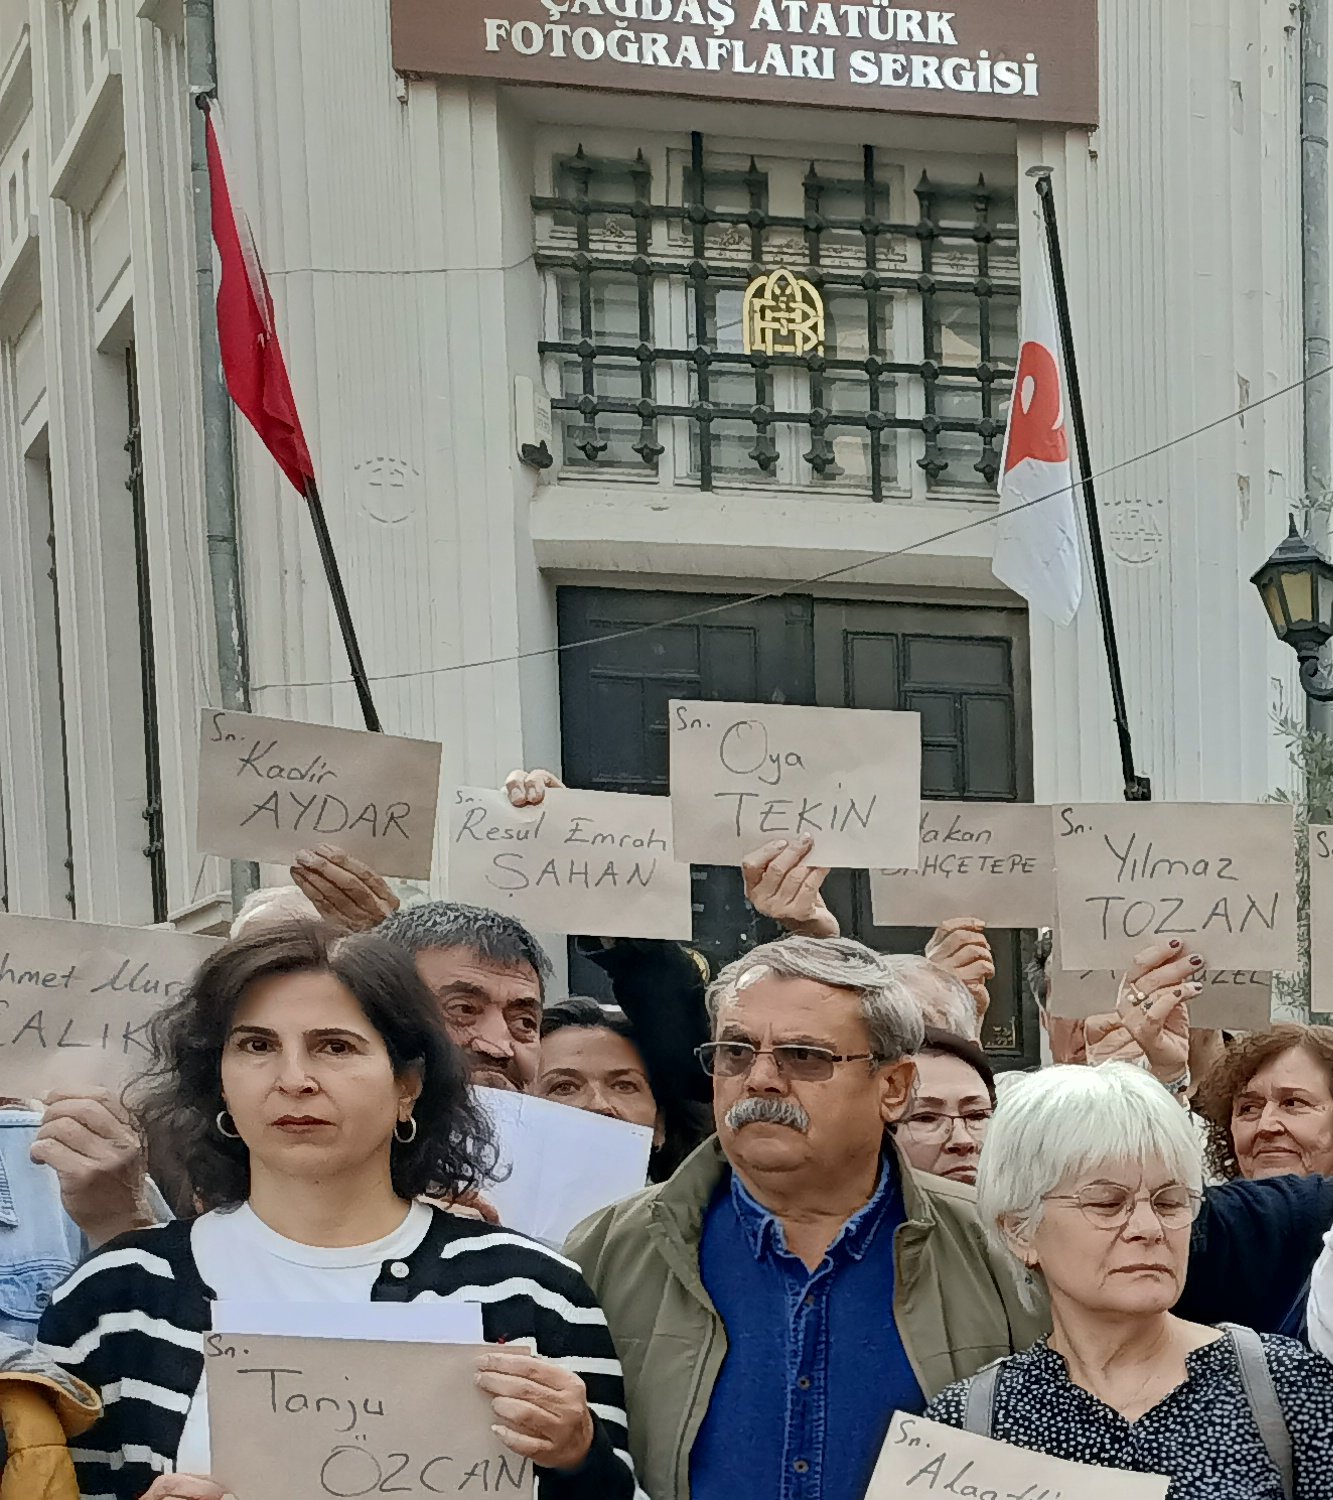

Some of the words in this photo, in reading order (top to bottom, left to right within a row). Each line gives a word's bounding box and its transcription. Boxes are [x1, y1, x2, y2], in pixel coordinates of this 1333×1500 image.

[750, 0, 958, 45] ATATÜRK
[484, 18, 836, 80] FOTOĞRAFLARI
[848, 49, 1039, 97] SERGİSİ
[211, 712, 245, 742] Sn.
[676, 707, 712, 731] Sn.
[237, 740, 338, 784] Kadir
[720, 719, 806, 785] Oya
[240, 790, 411, 839] AYDAR
[456, 807, 546, 843] Resul
[564, 817, 667, 851] Emrah
[714, 782, 877, 838] TEKİN
[1060, 807, 1093, 836] Sn.
[485, 853, 656, 898] ŞAHAN
[1085, 892, 1280, 941] TOZAN
[0, 952, 76, 990] hmet
[0, 1000, 158, 1056] ALIK
[206, 1334, 250, 1358] Sn.
[236, 1368, 385, 1432] Tanju
[894, 1419, 930, 1448] Sn.
[320, 1433, 530, 1498] ÖZCAN
